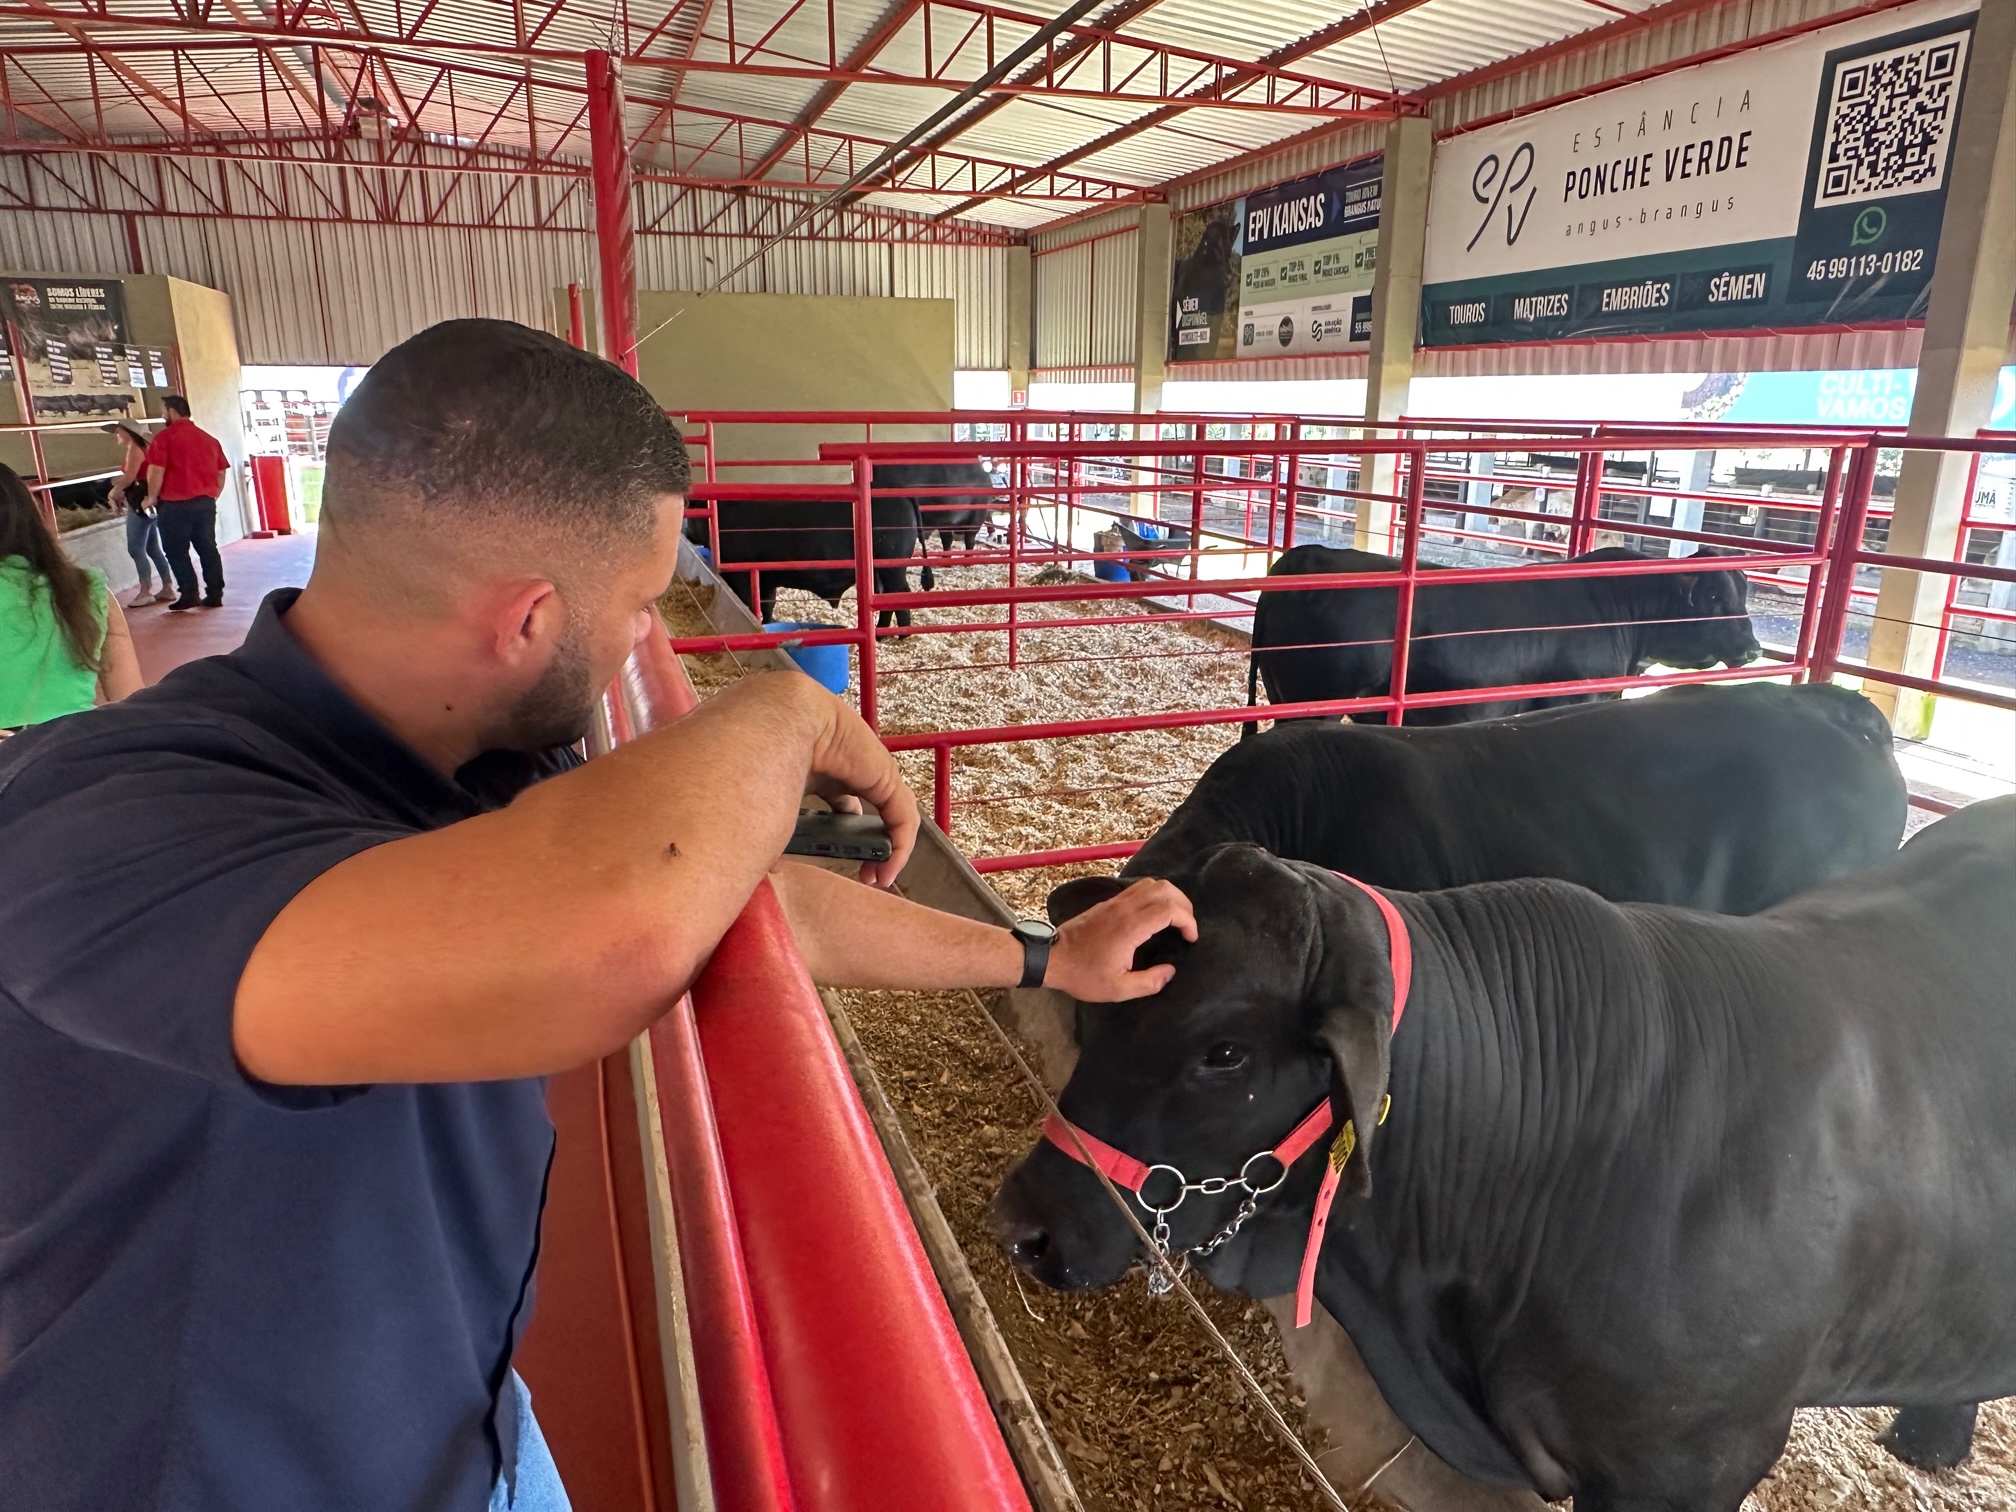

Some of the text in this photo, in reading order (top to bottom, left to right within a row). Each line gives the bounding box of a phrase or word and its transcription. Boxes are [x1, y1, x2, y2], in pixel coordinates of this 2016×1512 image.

[1573, 89, 1750, 153] ESTÂNCIA
[1563, 130, 1752, 203] PONCHE VERDE
[1248, 193, 1325, 243] EPV KANSAS
[1565, 196, 1735, 237] angus-brangus
[1806, 248, 1924, 281] 45 99113-0182
[1601, 281, 1671, 312] EMBRIÕES
[1708, 271, 1767, 303] SÊMEN
[1449, 302, 1486, 325] TOUROS
[1513, 293, 1569, 322] MATRIZES
[1819, 372, 1903, 397] CULTI-
[1816, 396, 1908, 420] VAMOS
